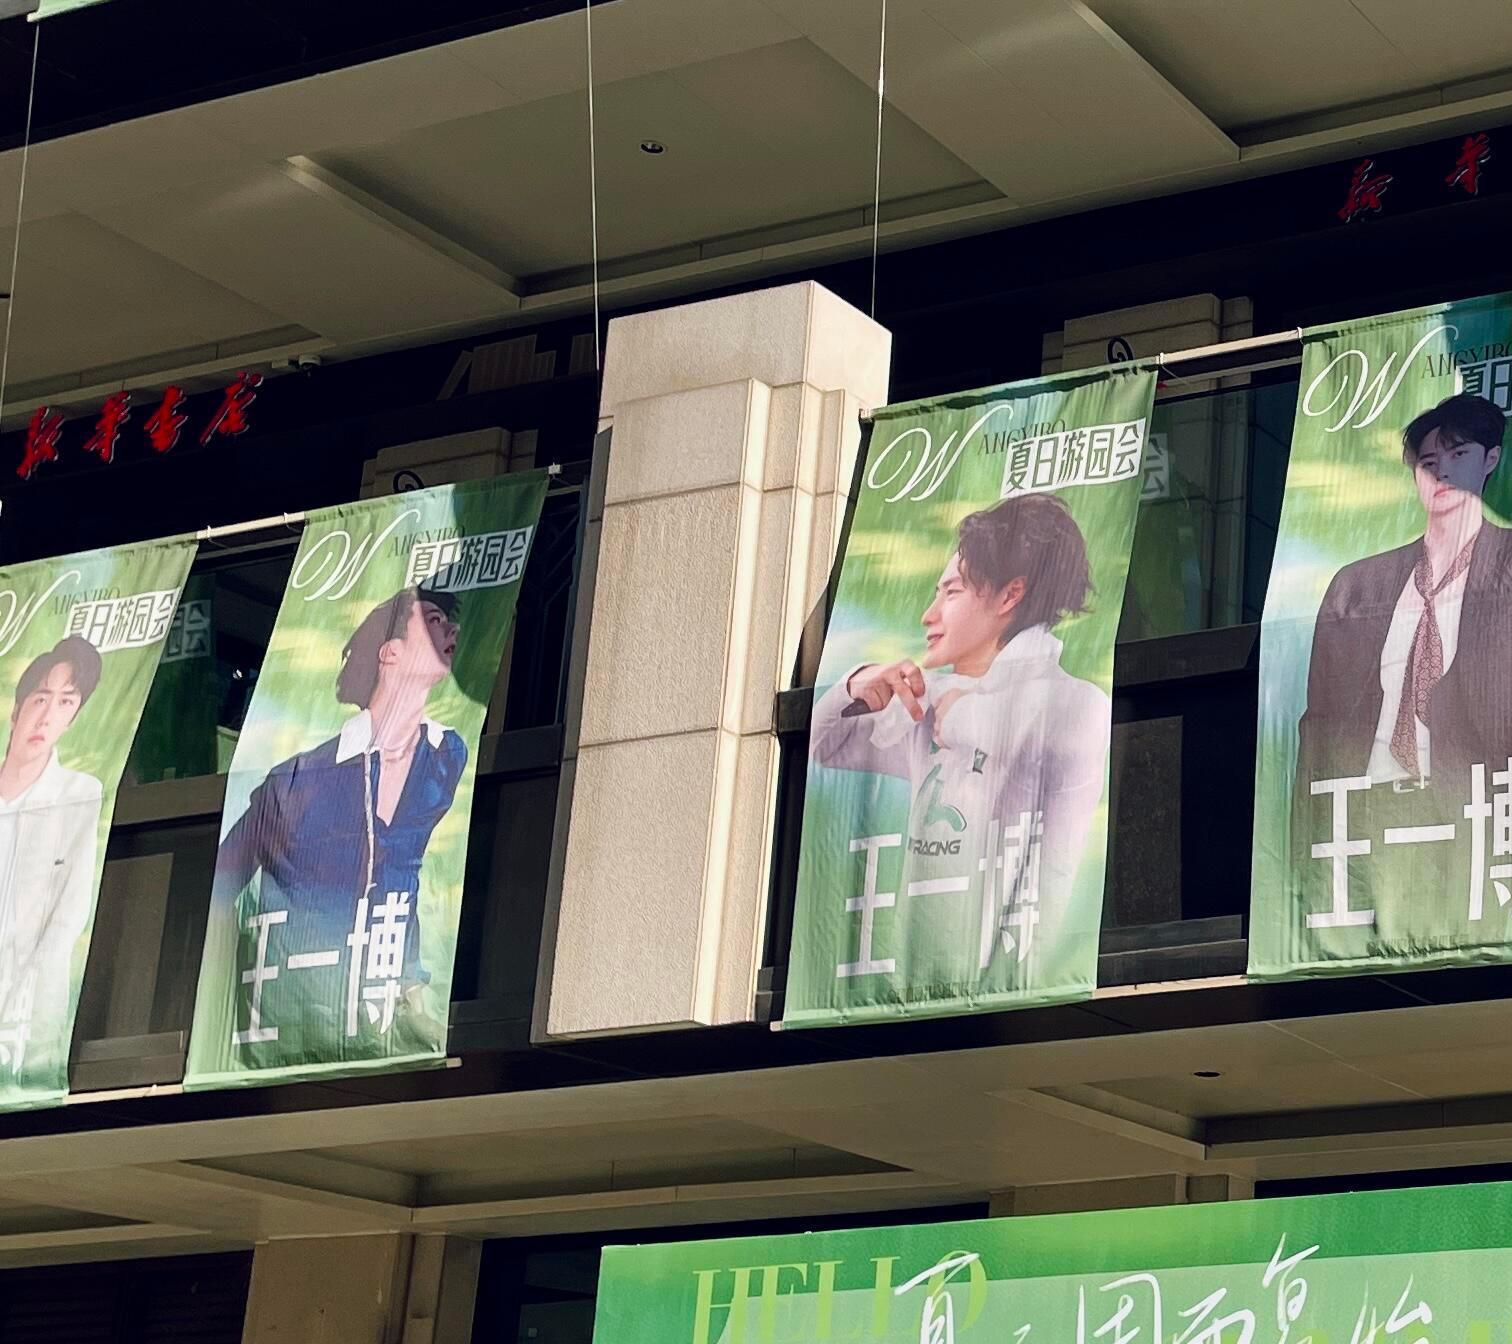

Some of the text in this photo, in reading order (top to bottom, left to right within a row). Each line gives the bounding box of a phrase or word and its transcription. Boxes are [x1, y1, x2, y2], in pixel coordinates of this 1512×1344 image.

[1006, 423, 1139, 490] 夏日游园会
[411, 530, 526, 590] 夏日游园会
[836, 810, 1043, 978] 王一博
[232, 892, 410, 1044] 王一博
